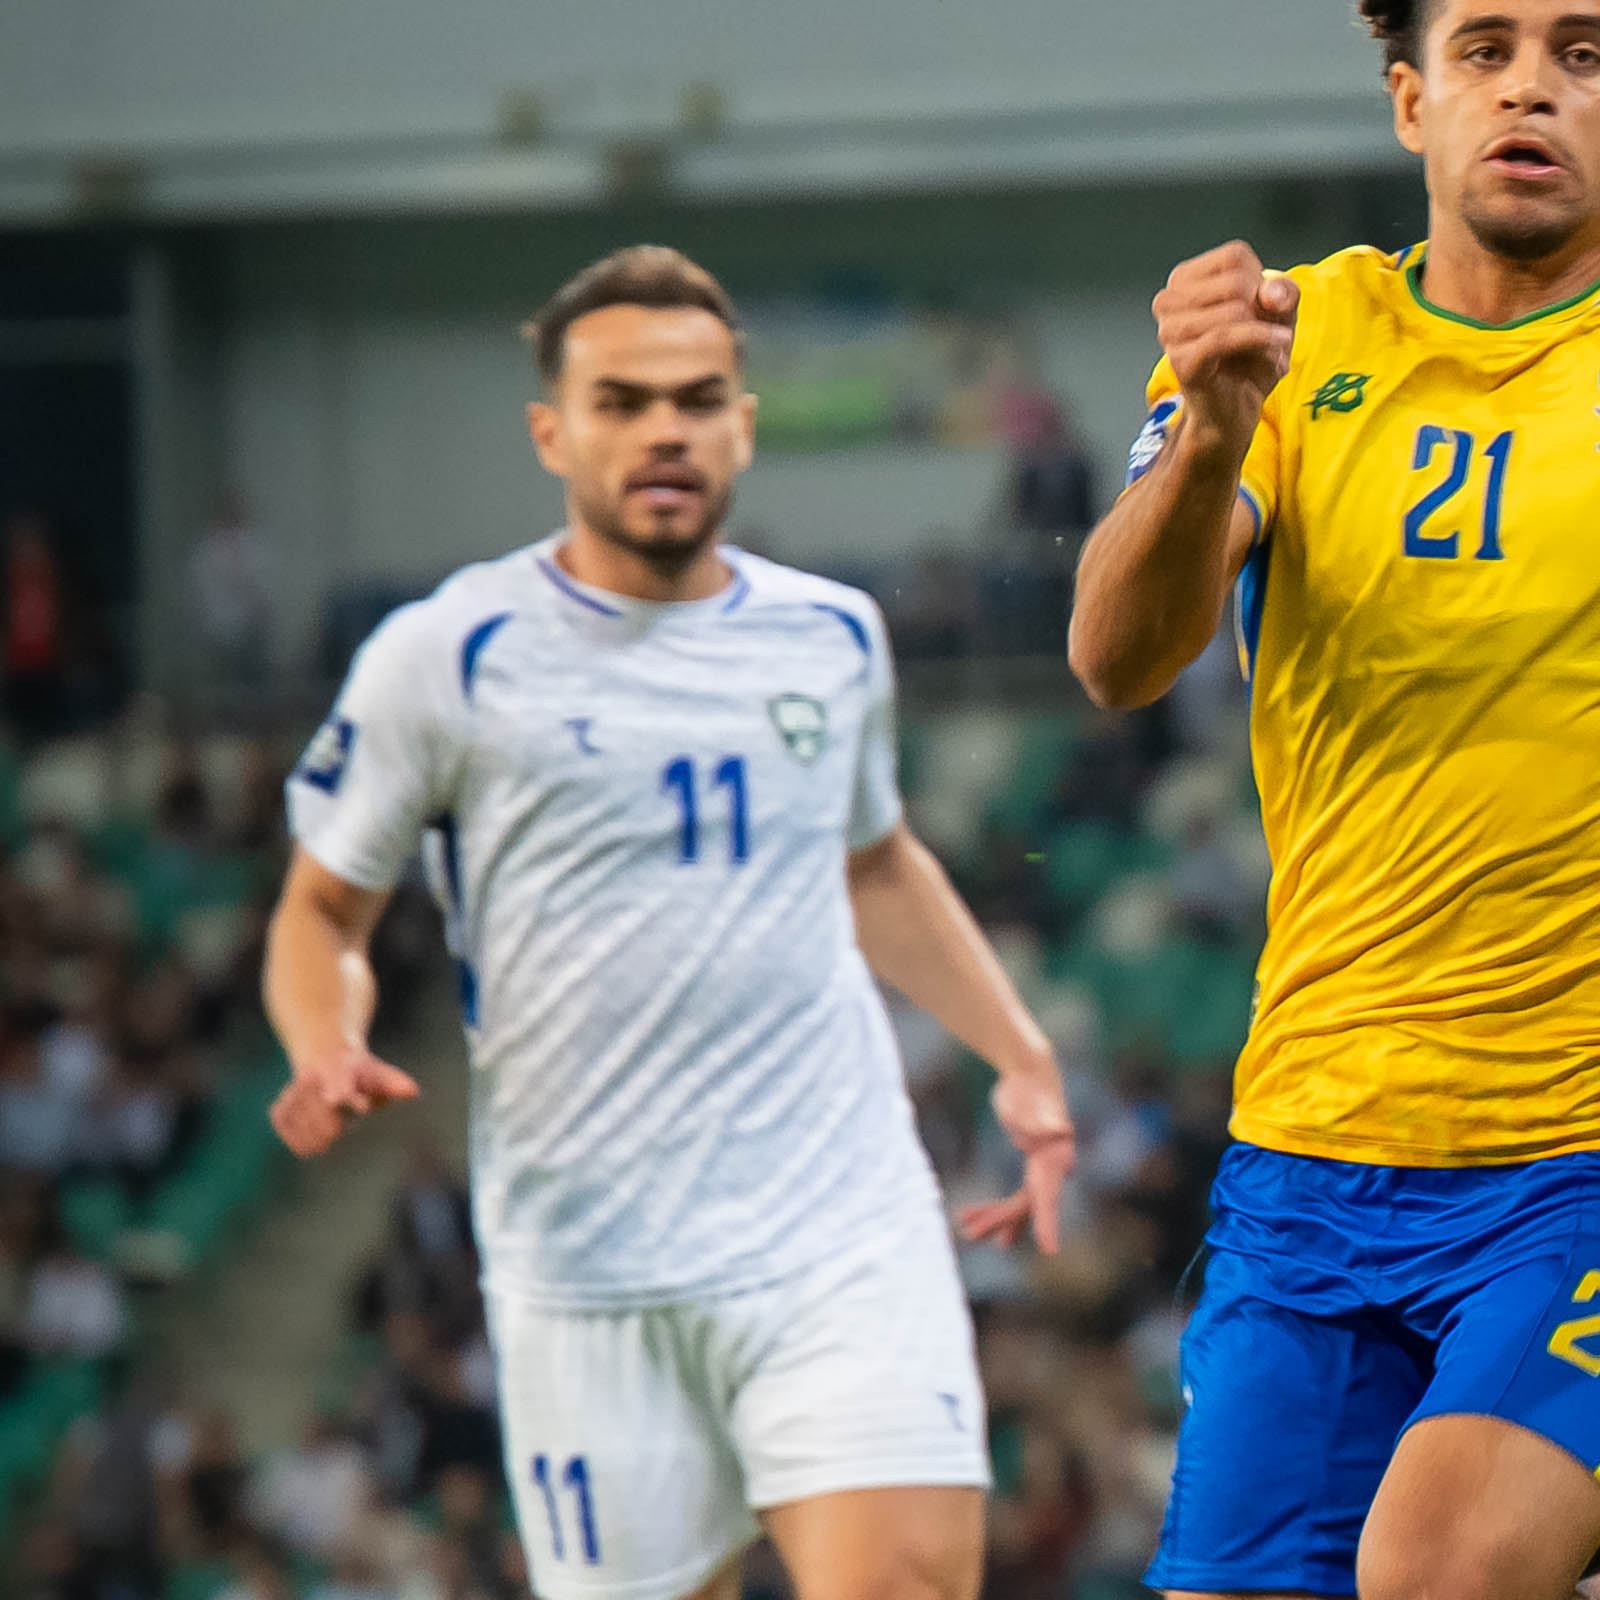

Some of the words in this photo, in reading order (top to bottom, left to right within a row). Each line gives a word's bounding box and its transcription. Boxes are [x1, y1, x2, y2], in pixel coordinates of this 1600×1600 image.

[1403, 424, 1514, 560] 21
[660, 754, 749, 865] 11
[530, 1453, 599, 1565] 11
